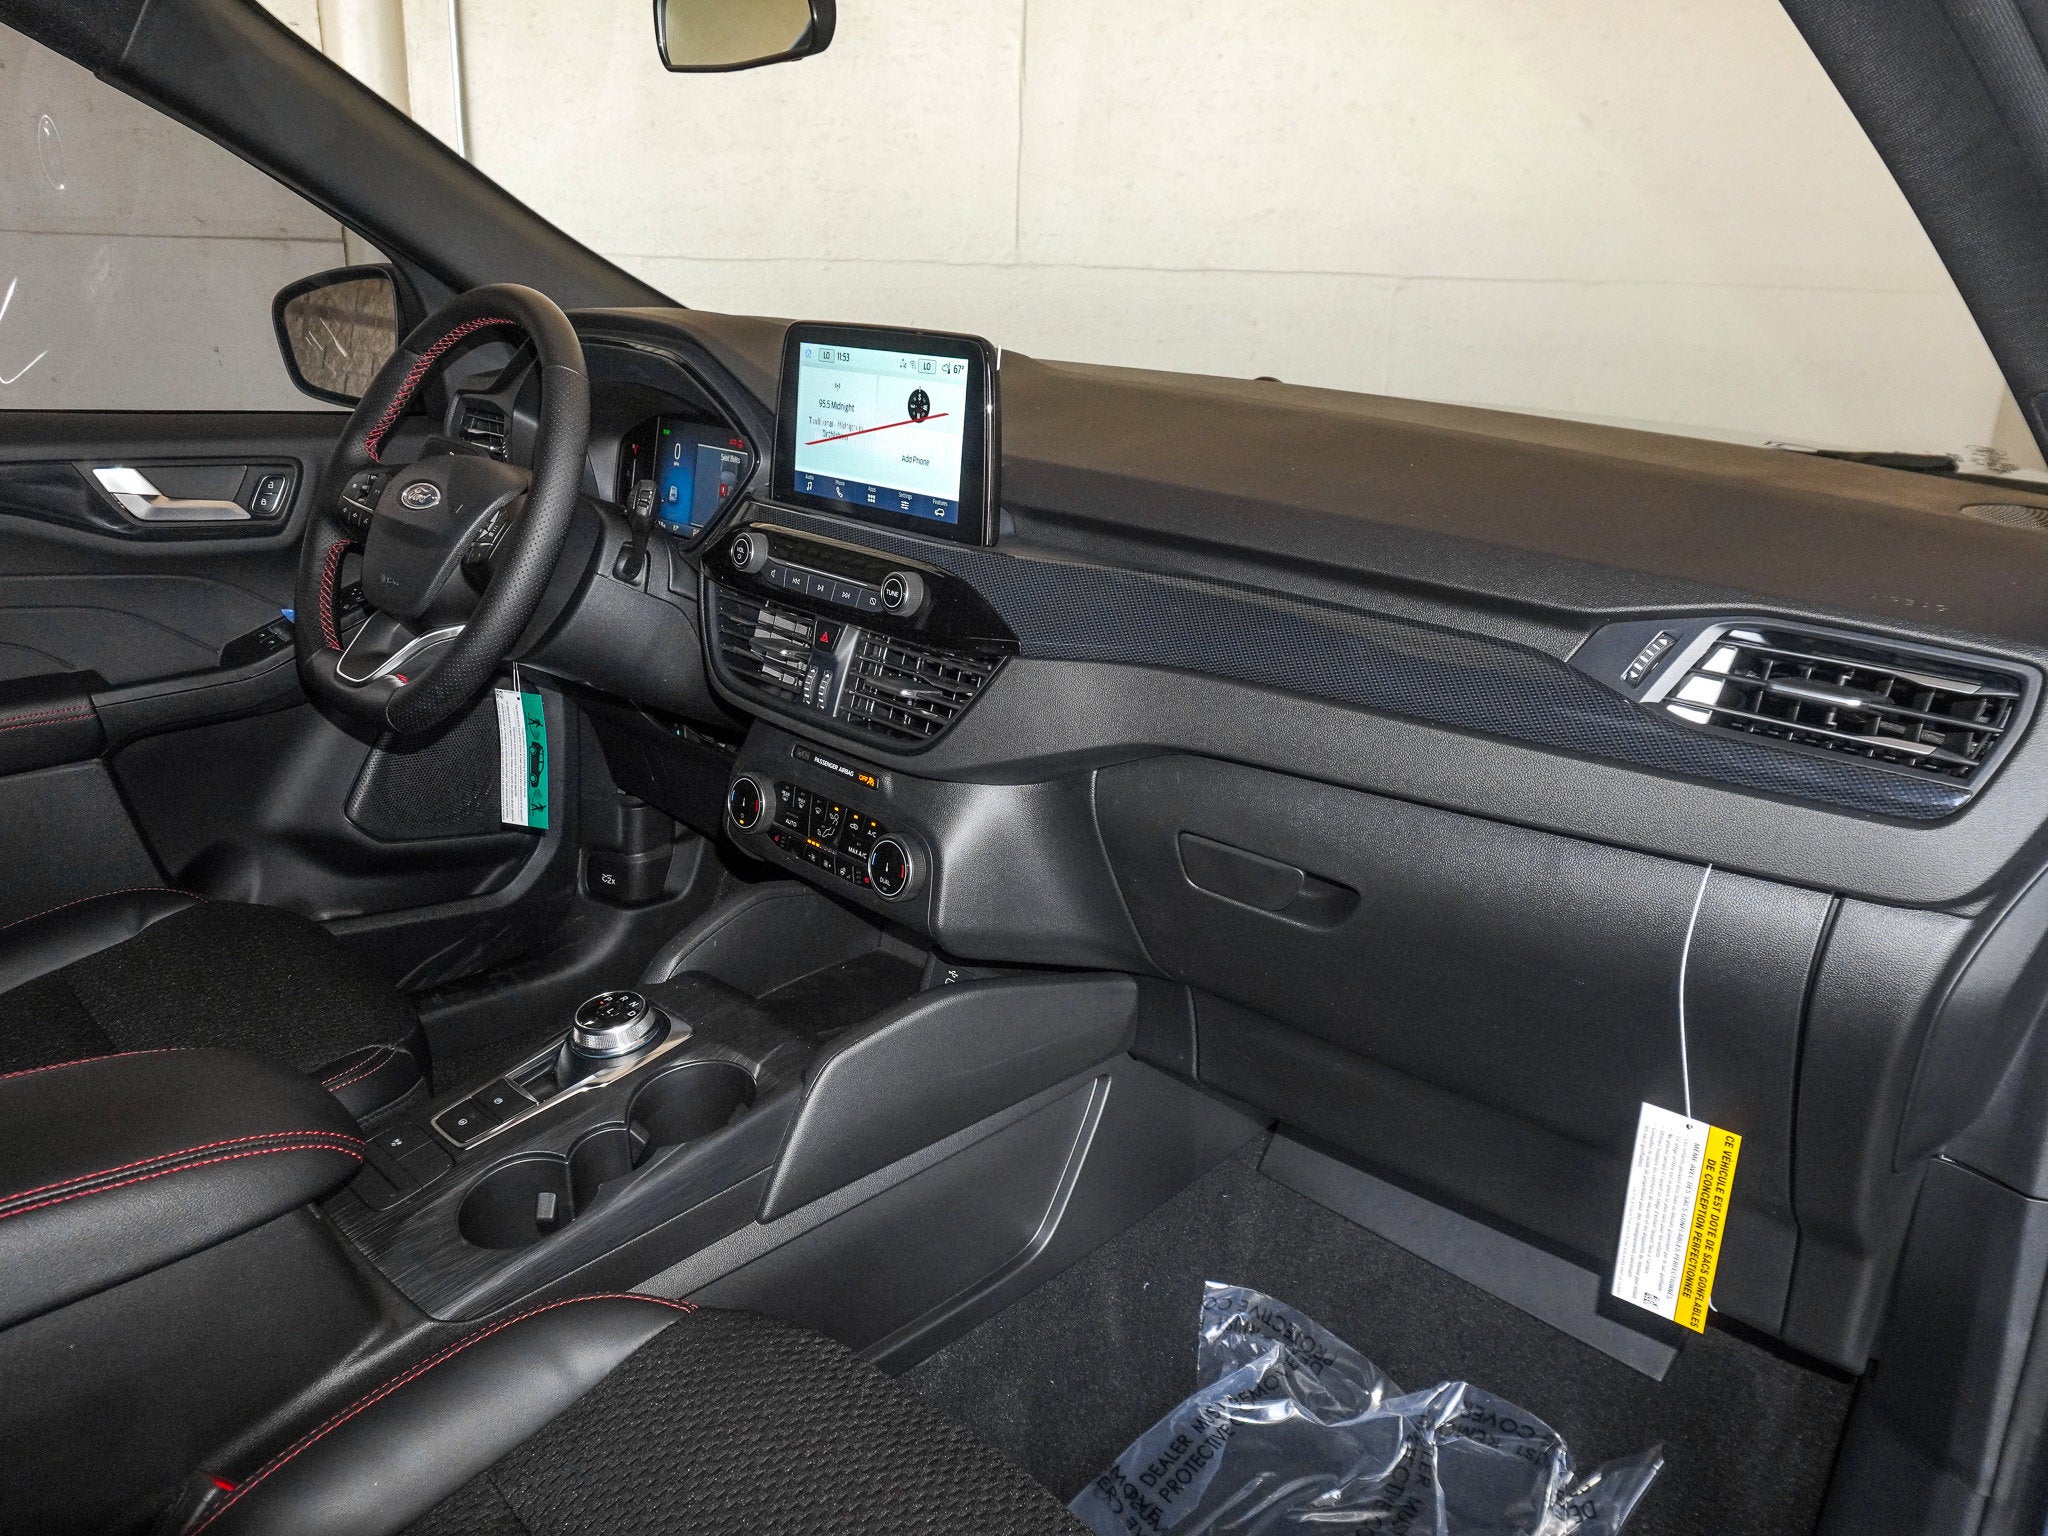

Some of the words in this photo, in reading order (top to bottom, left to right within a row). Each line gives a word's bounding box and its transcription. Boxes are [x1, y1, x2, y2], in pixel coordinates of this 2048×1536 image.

[823, 351, 831, 360] LO
[837, 352, 850, 362] 11:53
[923, 362, 931, 371] LO
[818, 398, 831, 409] 95.5
[831, 400, 855, 413] Midnight
[901, 455, 912, 464] Add
[912, 456, 931, 467] Phone
[886, 588, 899, 598] TUNE
[814, 756, 839, 771] PASSENGER
[838, 766, 854, 777] AIRBAG
[858, 774, 868, 782] OFF
[785, 818, 798, 828] AUTO
[867, 830, 877, 838] A/C
[1725, 1135, 1735, 1149] CE
[1705, 1158, 1717, 1172] DE
[1715, 1150, 1733, 1195] VÉHICULE
[1695, 1173, 1713, 1230] CONCEPTION
[1712, 1195, 1723, 1213] EST
[1707, 1213, 1720, 1239] DOTÉ
[1704, 1240, 1715, 1252] DE
[1682, 1230, 1703, 1299] PERFECTIONNÉE
[1700, 1252, 1712, 1275] SACS
[1688, 1276, 1708, 1328] GONFLABLES
[1140, 1434, 1194, 1487] DEALER
[1158, 1418, 1236, 1504] PROTECTIVE
